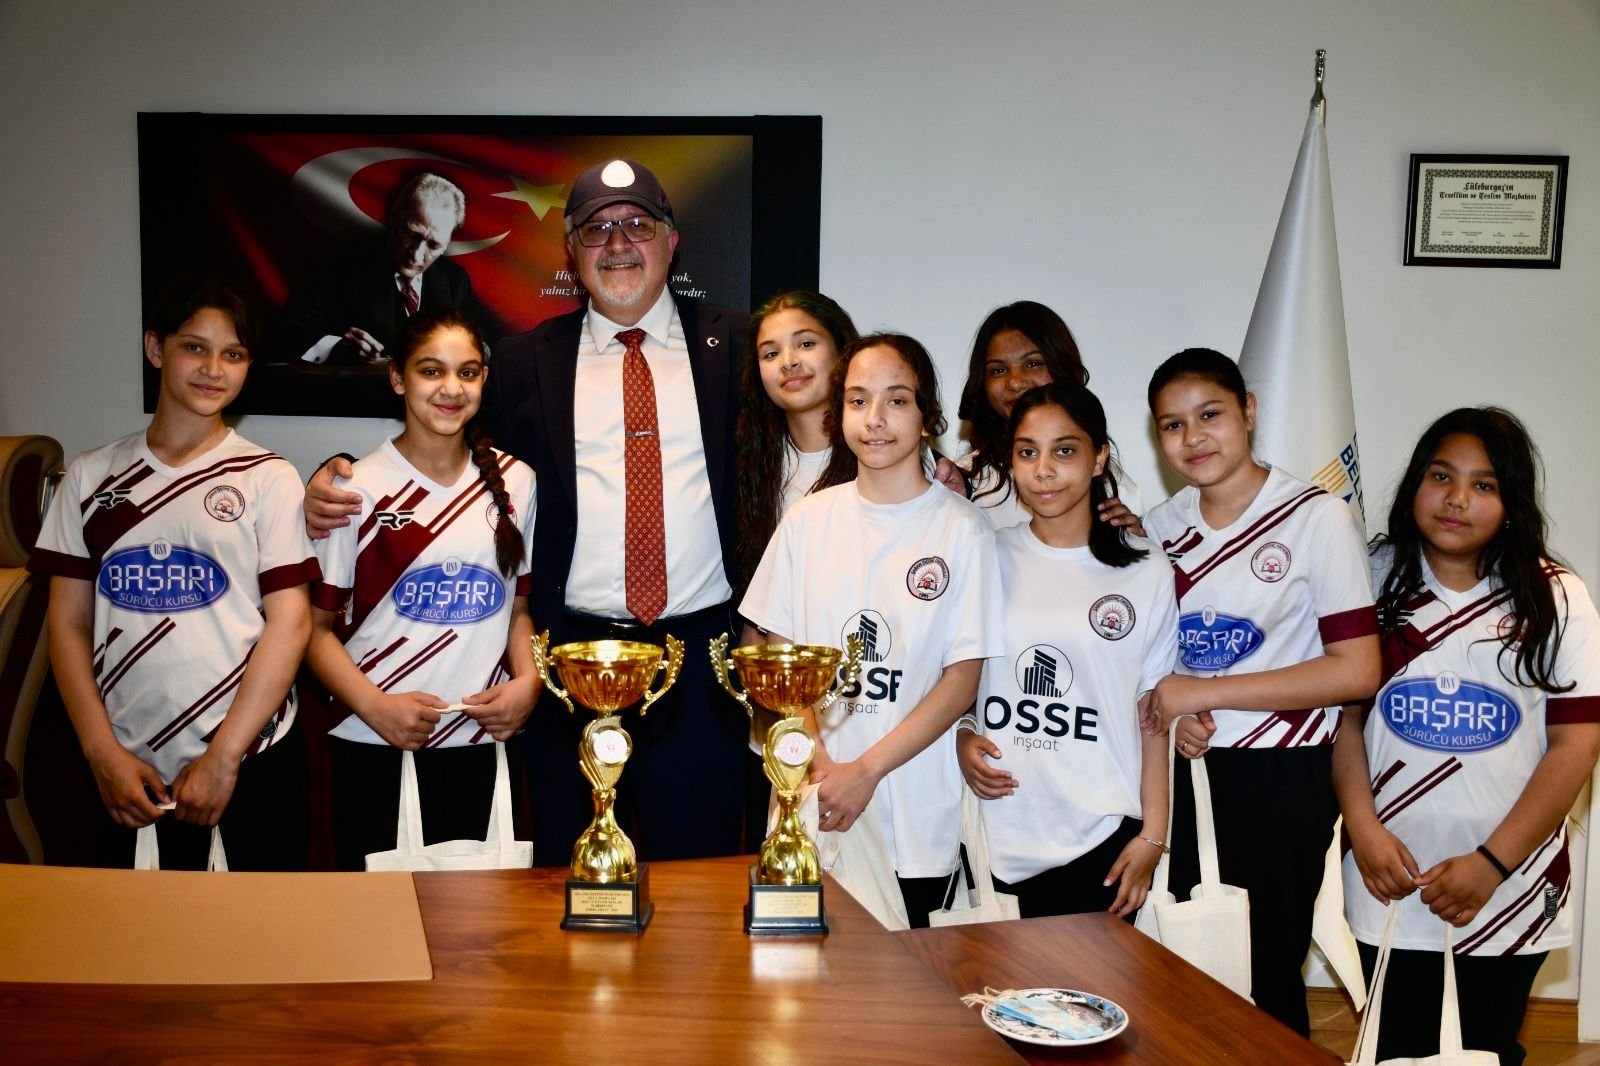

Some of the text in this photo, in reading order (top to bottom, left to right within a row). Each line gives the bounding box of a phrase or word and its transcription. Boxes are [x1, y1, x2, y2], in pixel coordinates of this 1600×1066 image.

[671, 272, 692, 284] yok,
[538, 285, 571, 298] yalnız
[675, 287, 707, 299] ardır;
[108, 564, 214, 595] BAŞARI
[119, 592, 203, 607] SÜRÜCÜ KURSU
[400, 580, 496, 608] BAŞARI
[450, 606, 483, 619] KURSU
[984, 695, 1099, 743] OSSE
[1390, 693, 1506, 732] BAŞARI
[1403, 724, 1492, 746] SÜRÜCÜ KURSU
